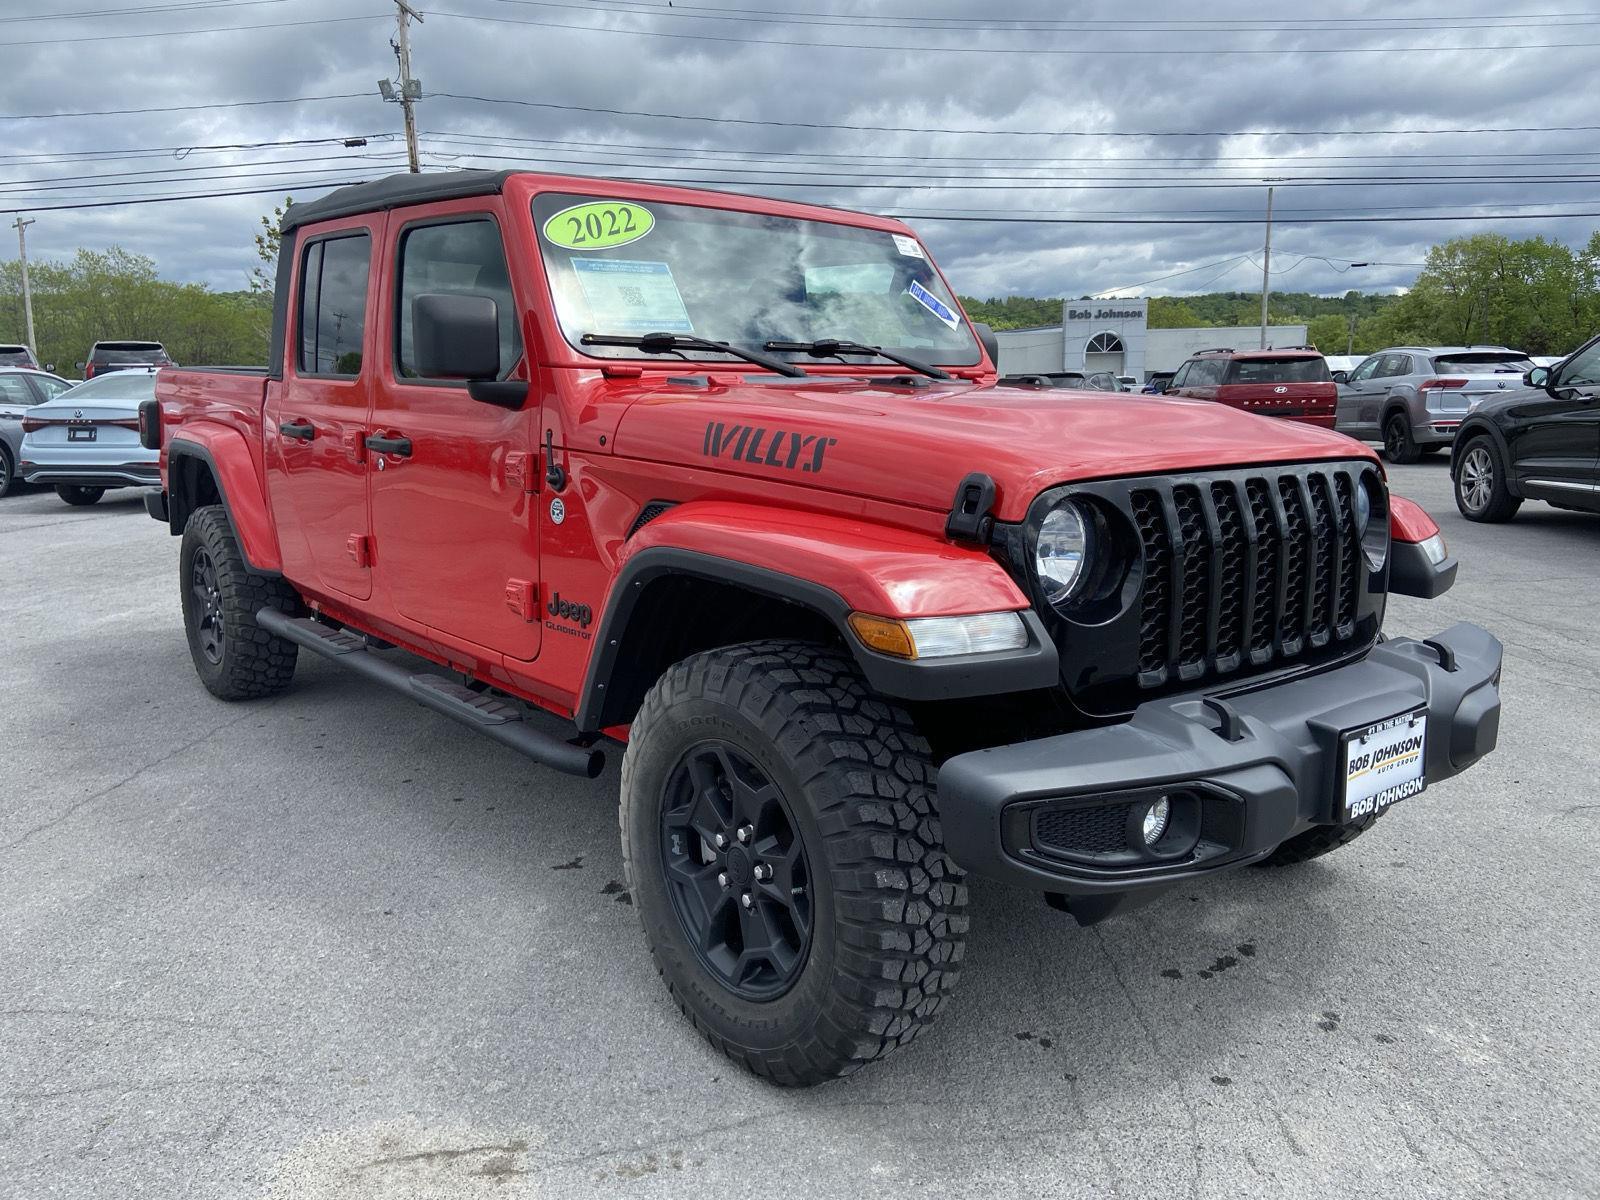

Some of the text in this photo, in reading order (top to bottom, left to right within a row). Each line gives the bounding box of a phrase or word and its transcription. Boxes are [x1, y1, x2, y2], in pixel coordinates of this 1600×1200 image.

[567, 207, 636, 244] 2022
[1068, 309, 1143, 320] Bob Johnson
[703, 421, 838, 473] WILLYS
[547, 591, 592, 629] Jeep
[545, 621, 592, 640] GLADIATOR
[1384, 720, 1395, 730] THE
[1348, 735, 1423, 775] BOB JOHNSON
[1378, 755, 1419, 774] AUTO GROUP
[1350, 776, 1424, 819] BOB JOHNSON
